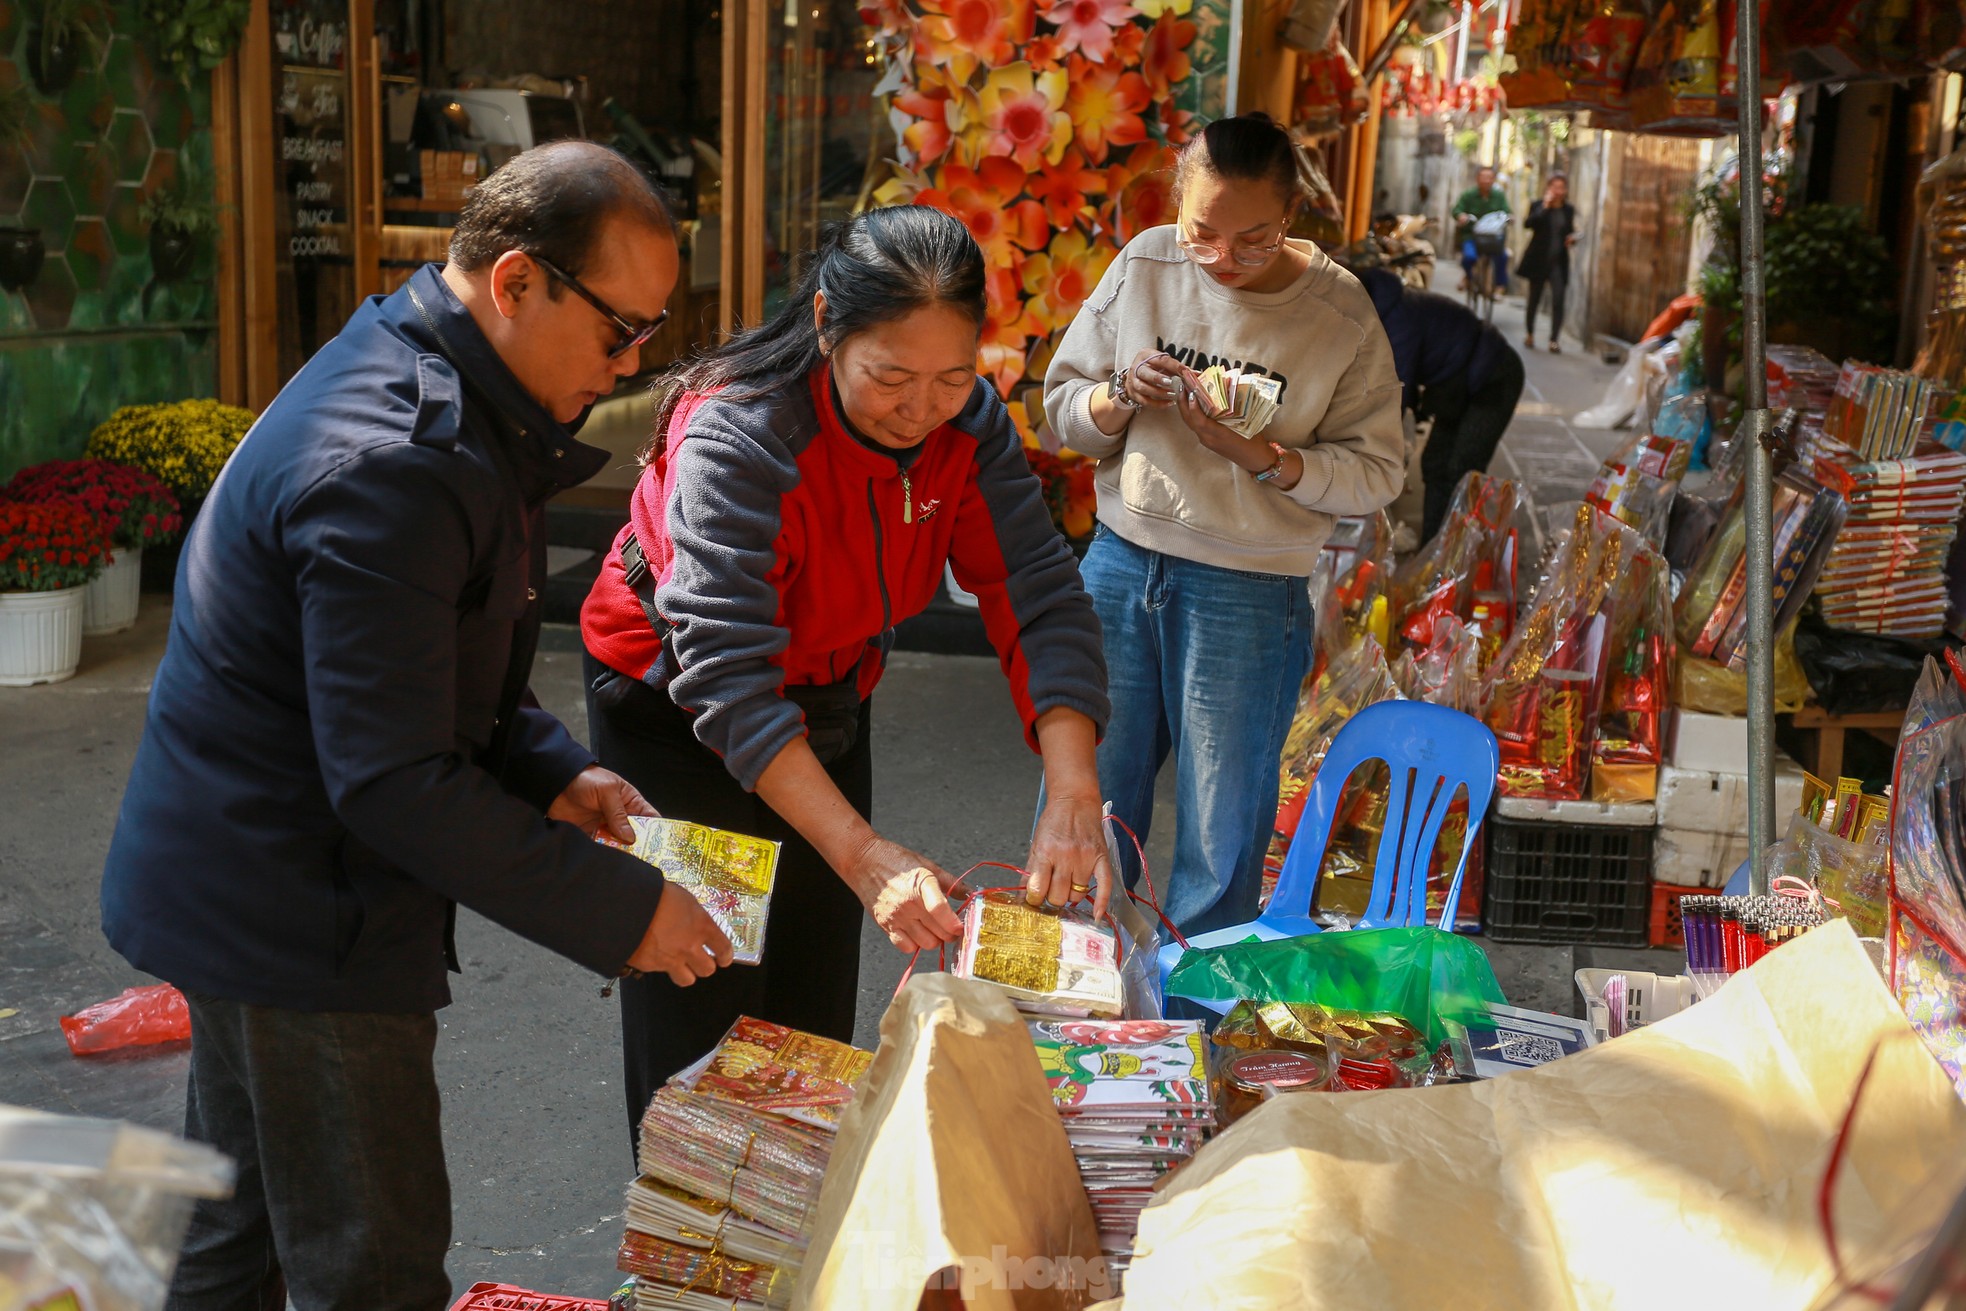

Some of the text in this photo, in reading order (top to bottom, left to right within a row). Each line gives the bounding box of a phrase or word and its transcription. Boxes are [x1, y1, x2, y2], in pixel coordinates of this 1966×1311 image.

[282, 136, 343, 161] BREAKFAST
[296, 181, 333, 201] PASTRY
[296, 208, 334, 229] SNACK
[289, 236, 341, 257] COCKTAIL
